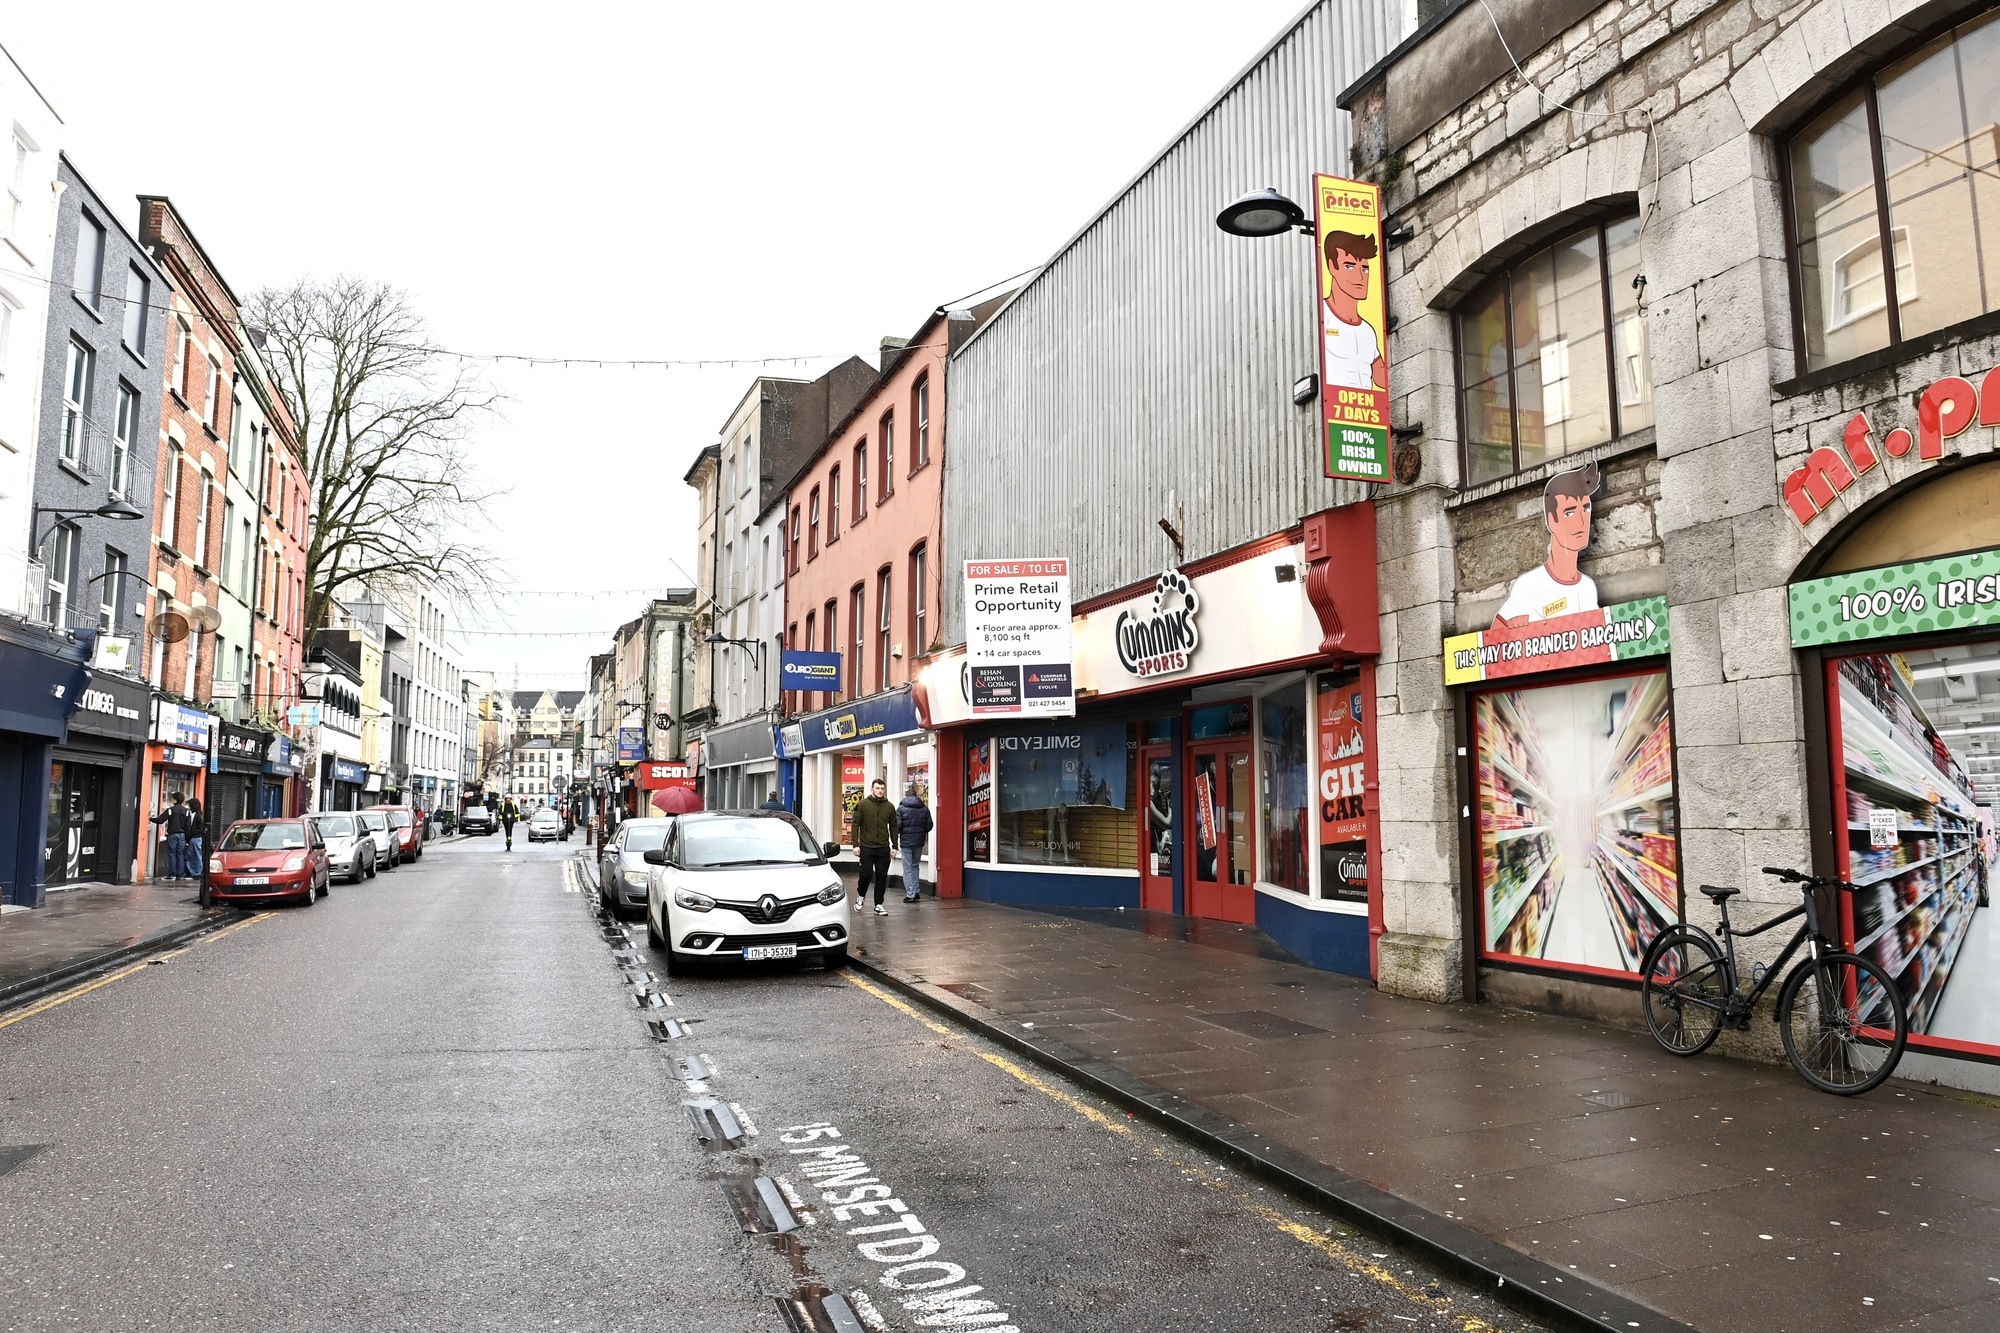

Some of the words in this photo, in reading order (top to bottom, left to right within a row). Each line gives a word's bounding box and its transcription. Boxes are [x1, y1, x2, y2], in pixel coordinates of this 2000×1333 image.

[1326, 193, 1372, 209] price
[1338, 390, 1374, 407] OPEN
[1333, 405, 1341, 418] 7
[1344, 406, 1379, 422] DAYS
[1341, 430, 1374, 444] 100%
[1341, 444, 1375, 459] IRISH
[1338, 459, 1382, 475] OWNED
[970, 566, 990, 575] FOR
[994, 565, 1019, 574] SALE
[1028, 564, 1042, 573] TO
[1045, 564, 1063, 572] LET
[975, 584, 1014, 595] Prime
[1020, 581, 1058, 594] Retail
[975, 598, 1061, 614] Opportunity
[1545, 600, 1564, 616] price
[1838, 584, 1925, 622] 100%
[984, 634, 1008, 642] 8,100
[1454, 649, 1476, 669] THIS
[1477, 644, 1500, 666] WAY
[1502, 641, 1522, 661] FOR
[1525, 630, 1577, 658] BRANDED
[1581, 619, 1644, 649] BARGAINS
[1013, 650, 1041, 658] spaces
[1138, 652, 1184, 676] SPORTS
[652, 766, 687, 778] SCOT
[1320, 762, 1364, 800] GIF
[1322, 796, 1365, 823] CAR
[1337, 823, 1361, 834] AVAILABLE
[1338, 856, 1367, 883] CUMMI
[751, 947, 793, 957] 171-D-35328
